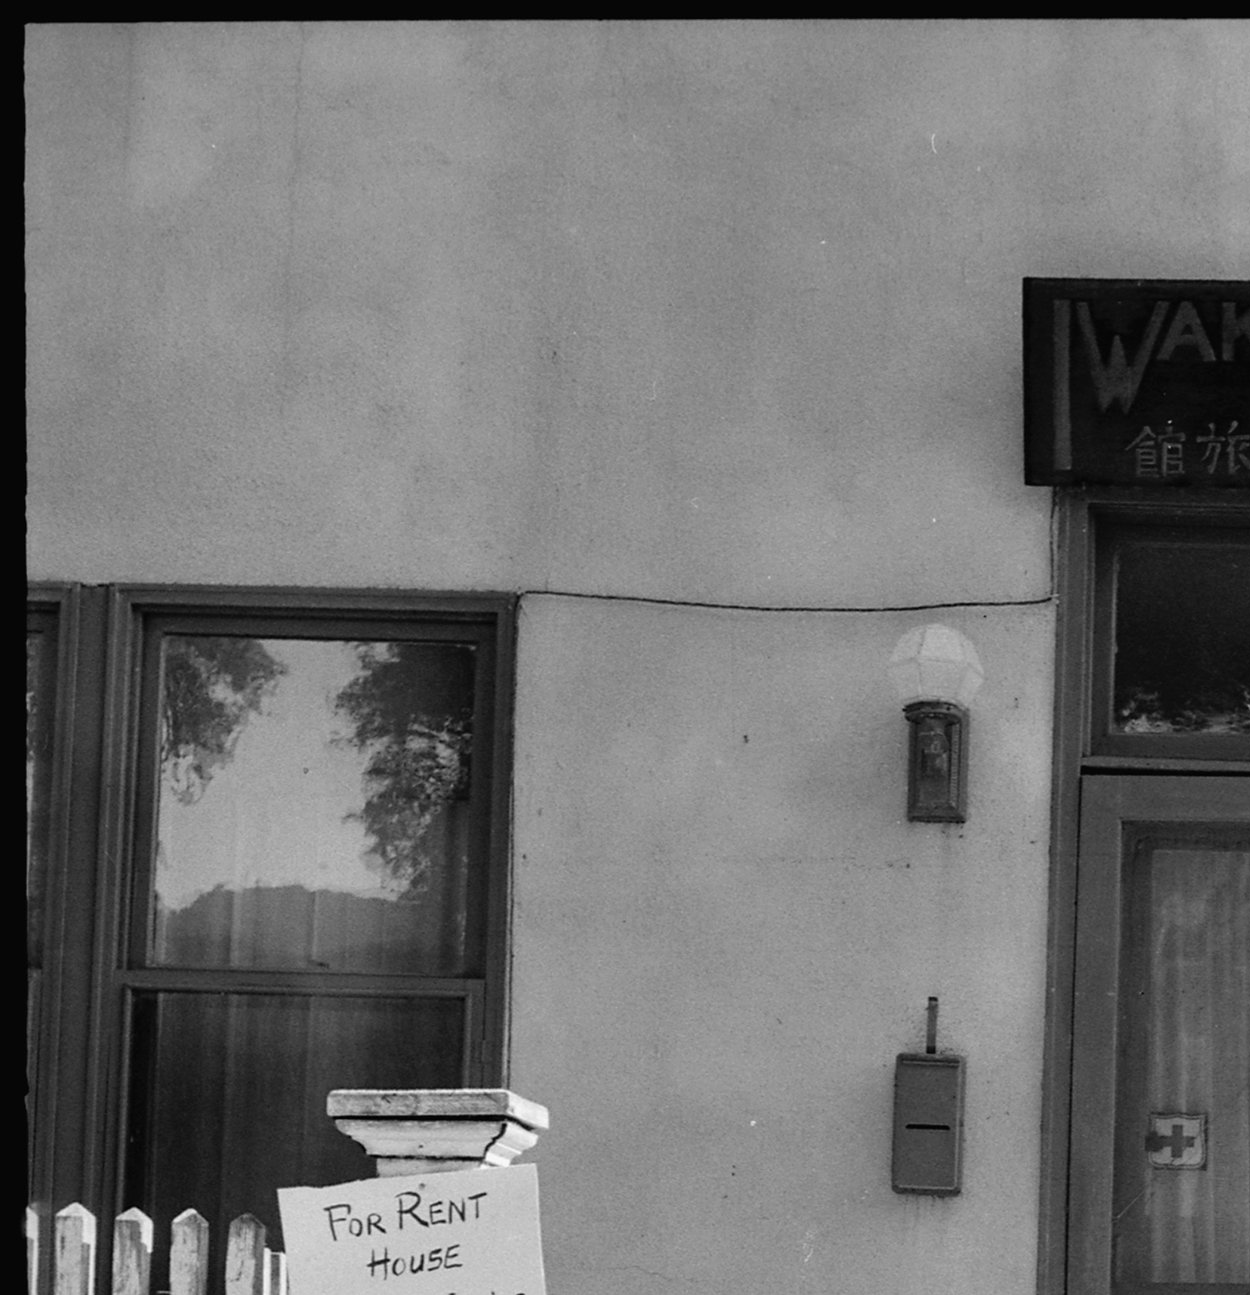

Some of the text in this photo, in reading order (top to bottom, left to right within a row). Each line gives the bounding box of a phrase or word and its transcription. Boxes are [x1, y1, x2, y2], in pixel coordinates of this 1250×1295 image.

[323, 1190, 488, 1242] FOR RENT
[366, 1243, 463, 1281] HOUSE
